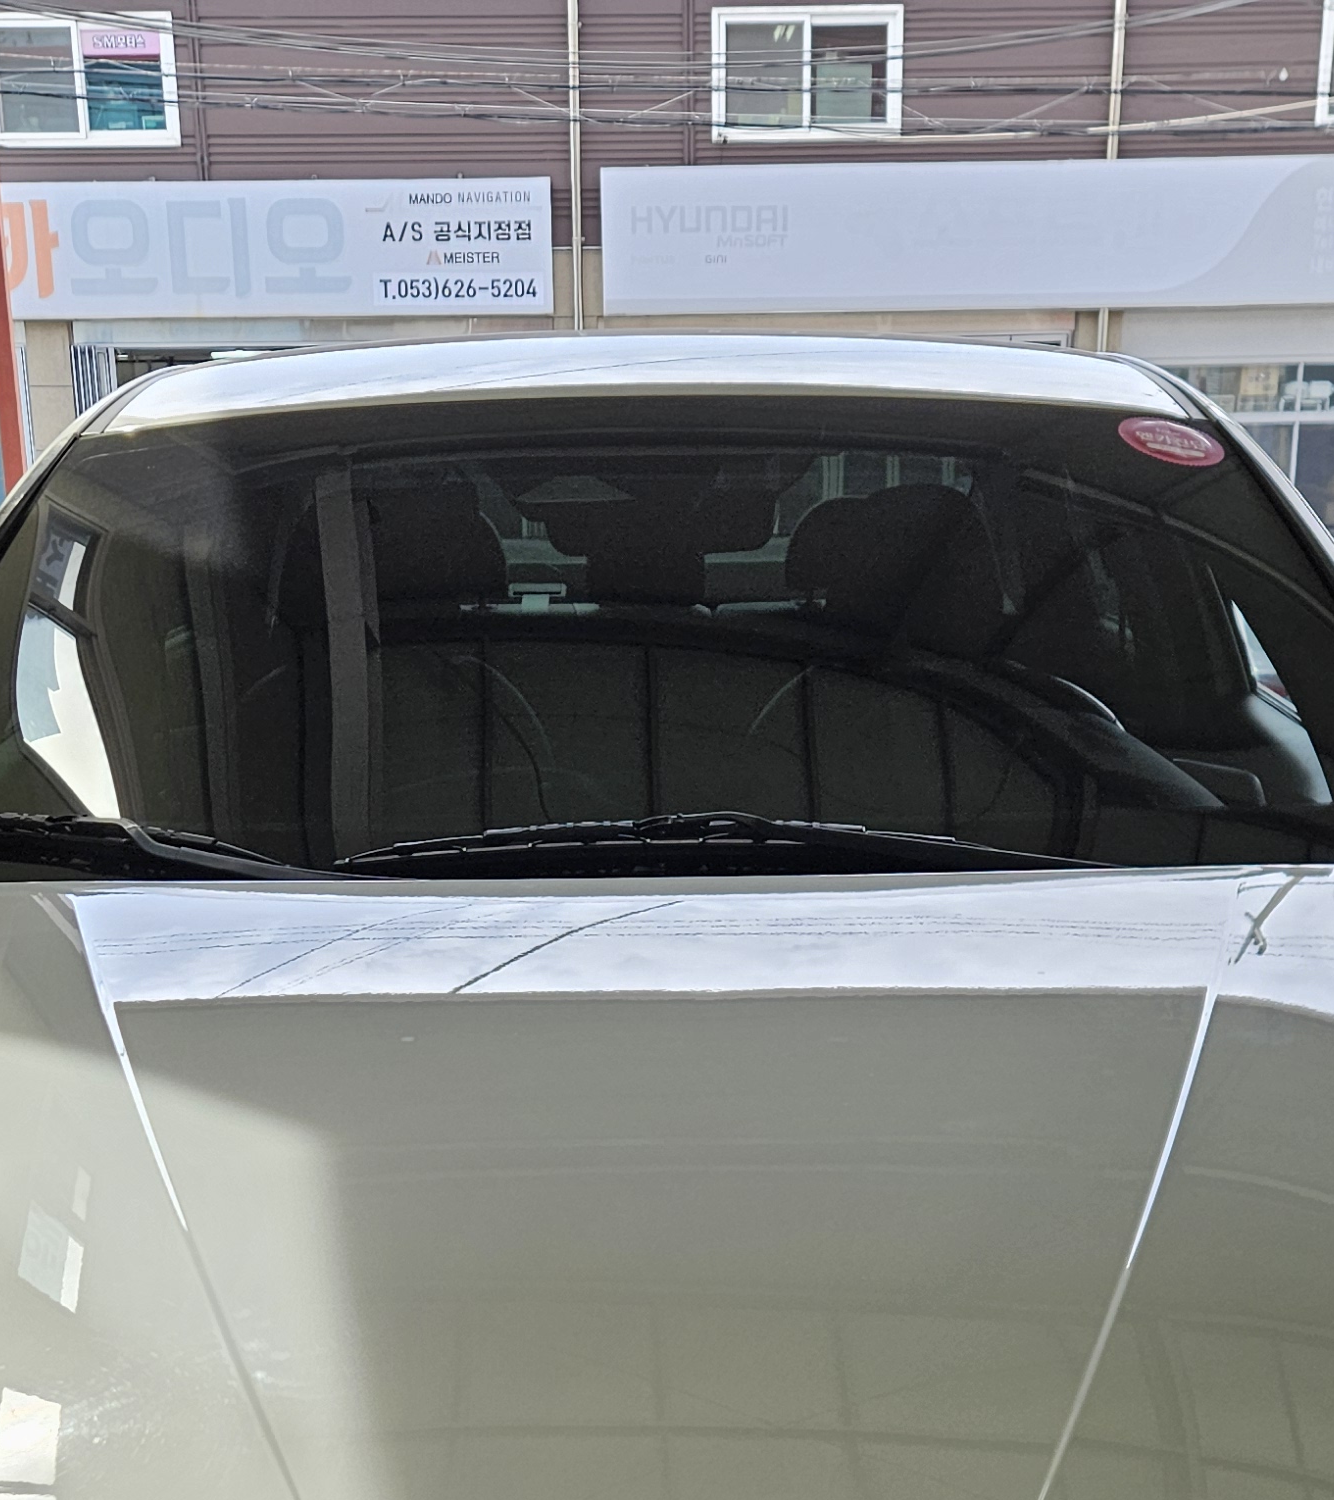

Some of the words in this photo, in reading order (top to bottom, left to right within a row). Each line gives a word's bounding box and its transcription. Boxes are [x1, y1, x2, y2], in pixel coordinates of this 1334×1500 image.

[92, 34, 146, 49] SM모터스
[409, 193, 452, 205] MANDO
[457, 191, 531, 204] NAVIGATION
[630, 205, 789, 235] HYUNDAI
[382, 222, 423, 242] A/S
[434, 220, 533, 242] 공식지정점
[716, 234, 789, 248] MnSOFT
[444, 251, 501, 264] MEISTER
[379, 277, 538, 300] T.053)626-5204
